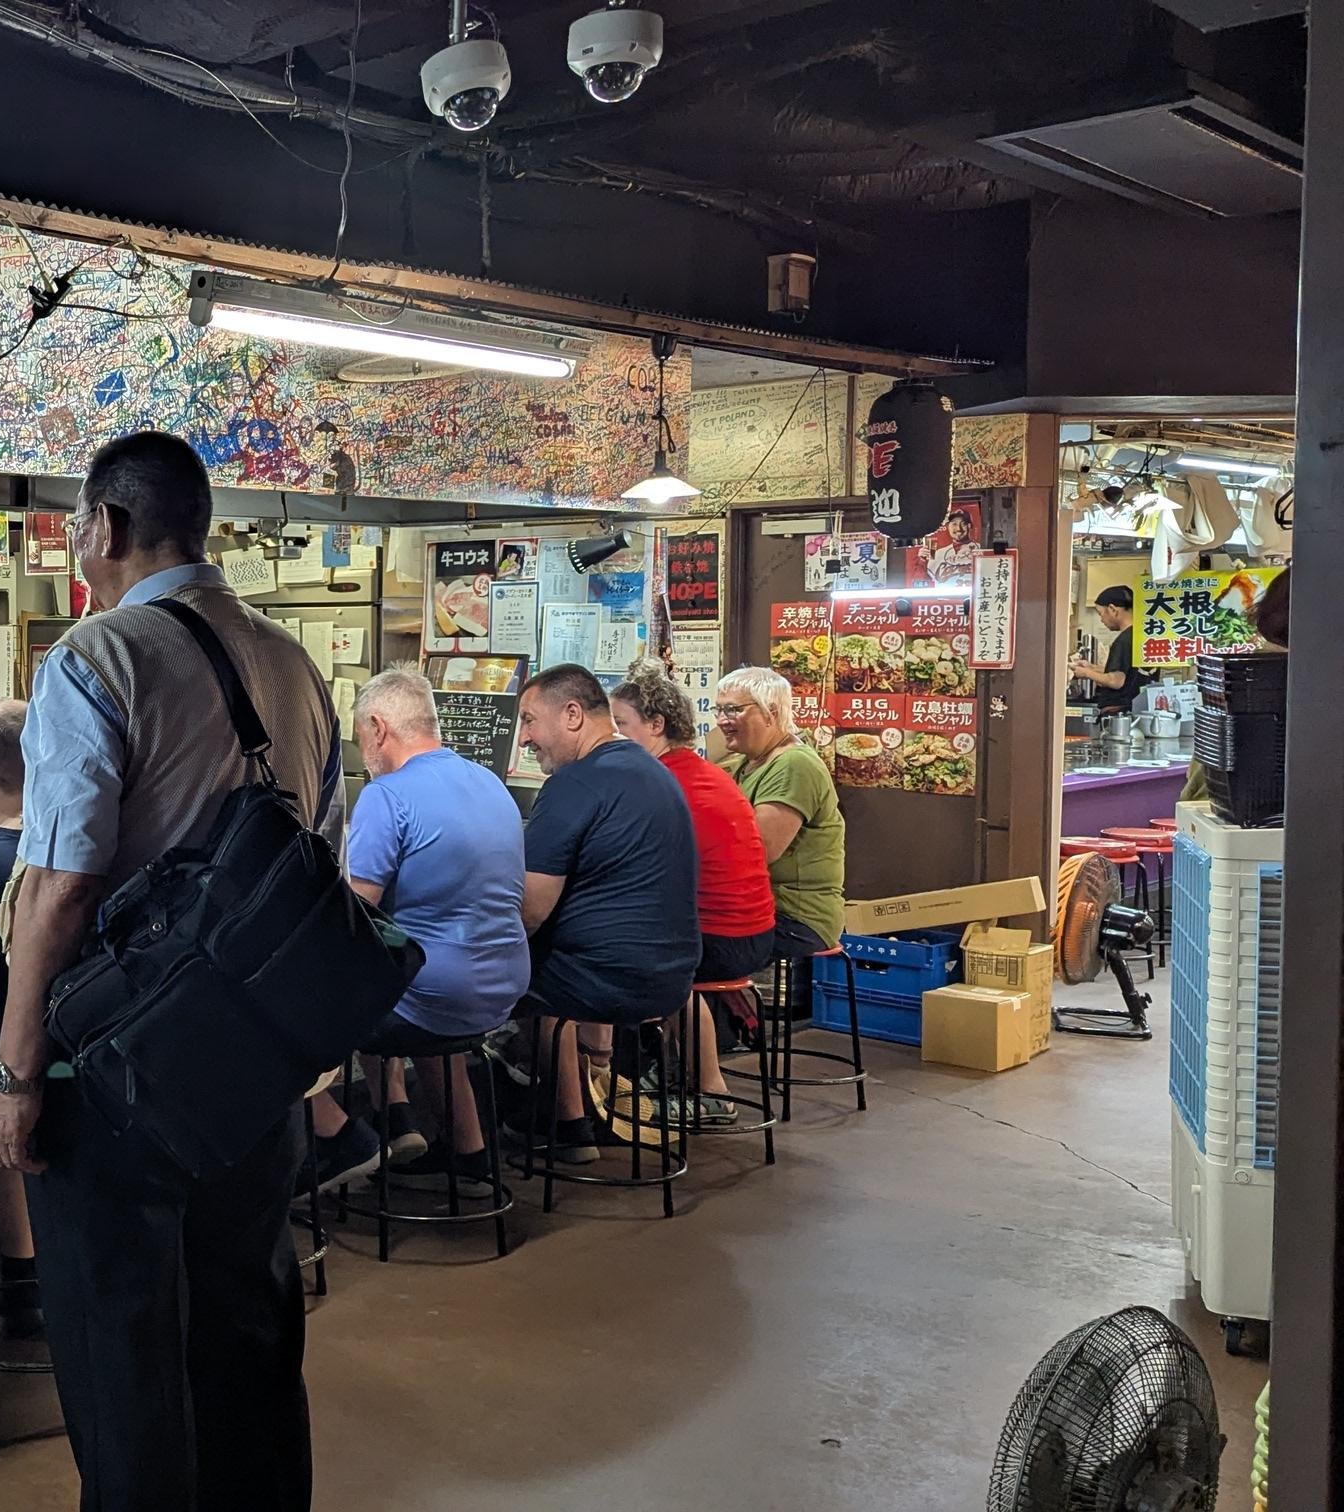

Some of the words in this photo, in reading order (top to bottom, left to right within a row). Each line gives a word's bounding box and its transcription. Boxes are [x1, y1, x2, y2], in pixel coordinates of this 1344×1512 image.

[719, 409, 756, 424] POLAND
[440, 549, 490, 567] 牛コウネ
[848, 602, 892, 614] チーズ
[918, 604, 965, 616] HOPE
[995, 558, 1010, 660] お持ち帰りできます
[1144, 590, 1214, 617] 大根
[783, 606, 827, 618] 辛焼き
[977, 577, 992, 661] お土産にどうぞ
[778, 618, 831, 629] スペシャル
[842, 614, 899, 626] スペシャル
[911, 616, 970, 627] スペシャル
[1143, 616, 1219, 636] おろし
[1143, 637, 1204, 663] 無料
[683, 673, 691, 688] 4
[700, 673, 708, 688] 5
[697, 698, 709, 712] 12
[851, 699, 888, 709] BIG
[912, 701, 974, 715] 広島牡蠣
[791, 708, 830, 719] ペシャル
[842, 710, 899, 721] スペシャル
[912, 713, 972, 725] スペシャル
[697, 723, 709, 737] 19
